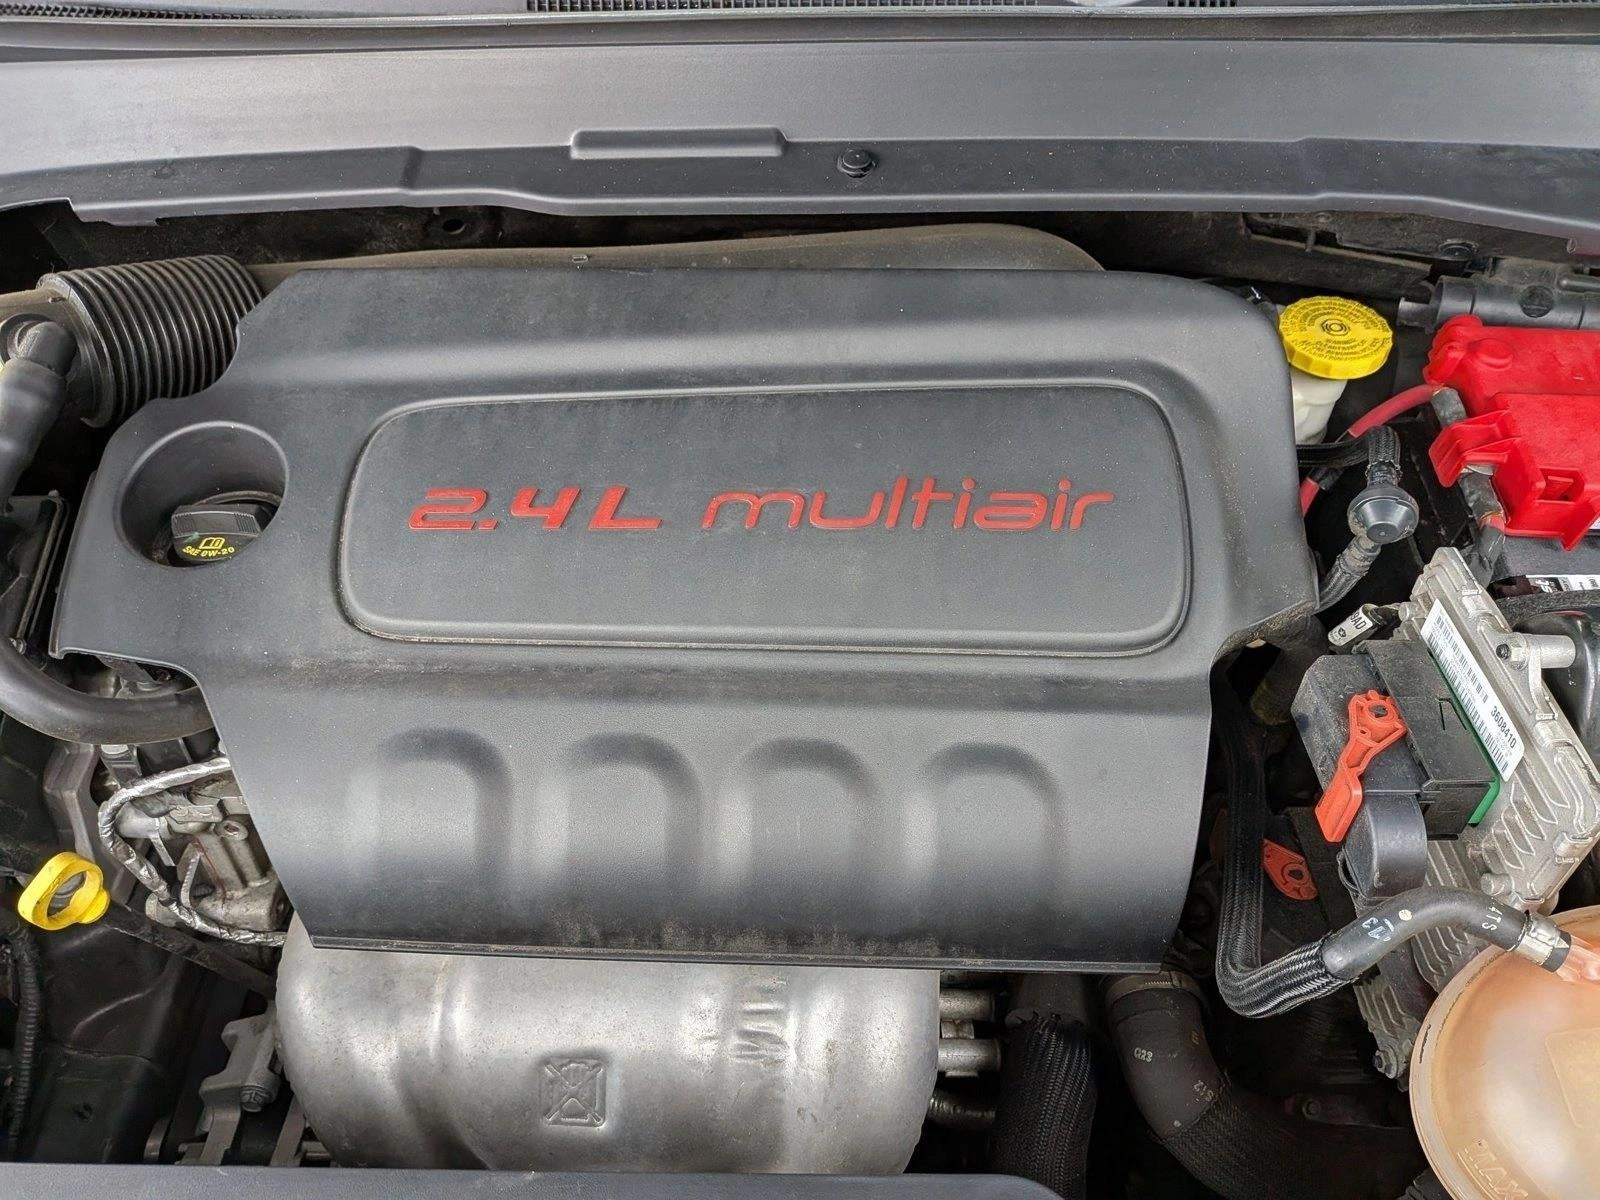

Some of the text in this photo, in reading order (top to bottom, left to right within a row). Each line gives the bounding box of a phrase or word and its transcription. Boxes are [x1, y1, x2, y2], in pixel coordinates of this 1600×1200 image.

[408, 476, 1114, 531] 2.4L multiair
[182, 545, 235, 557] SAE 0W-20
[1490, 705, 1517, 750] 3608410
